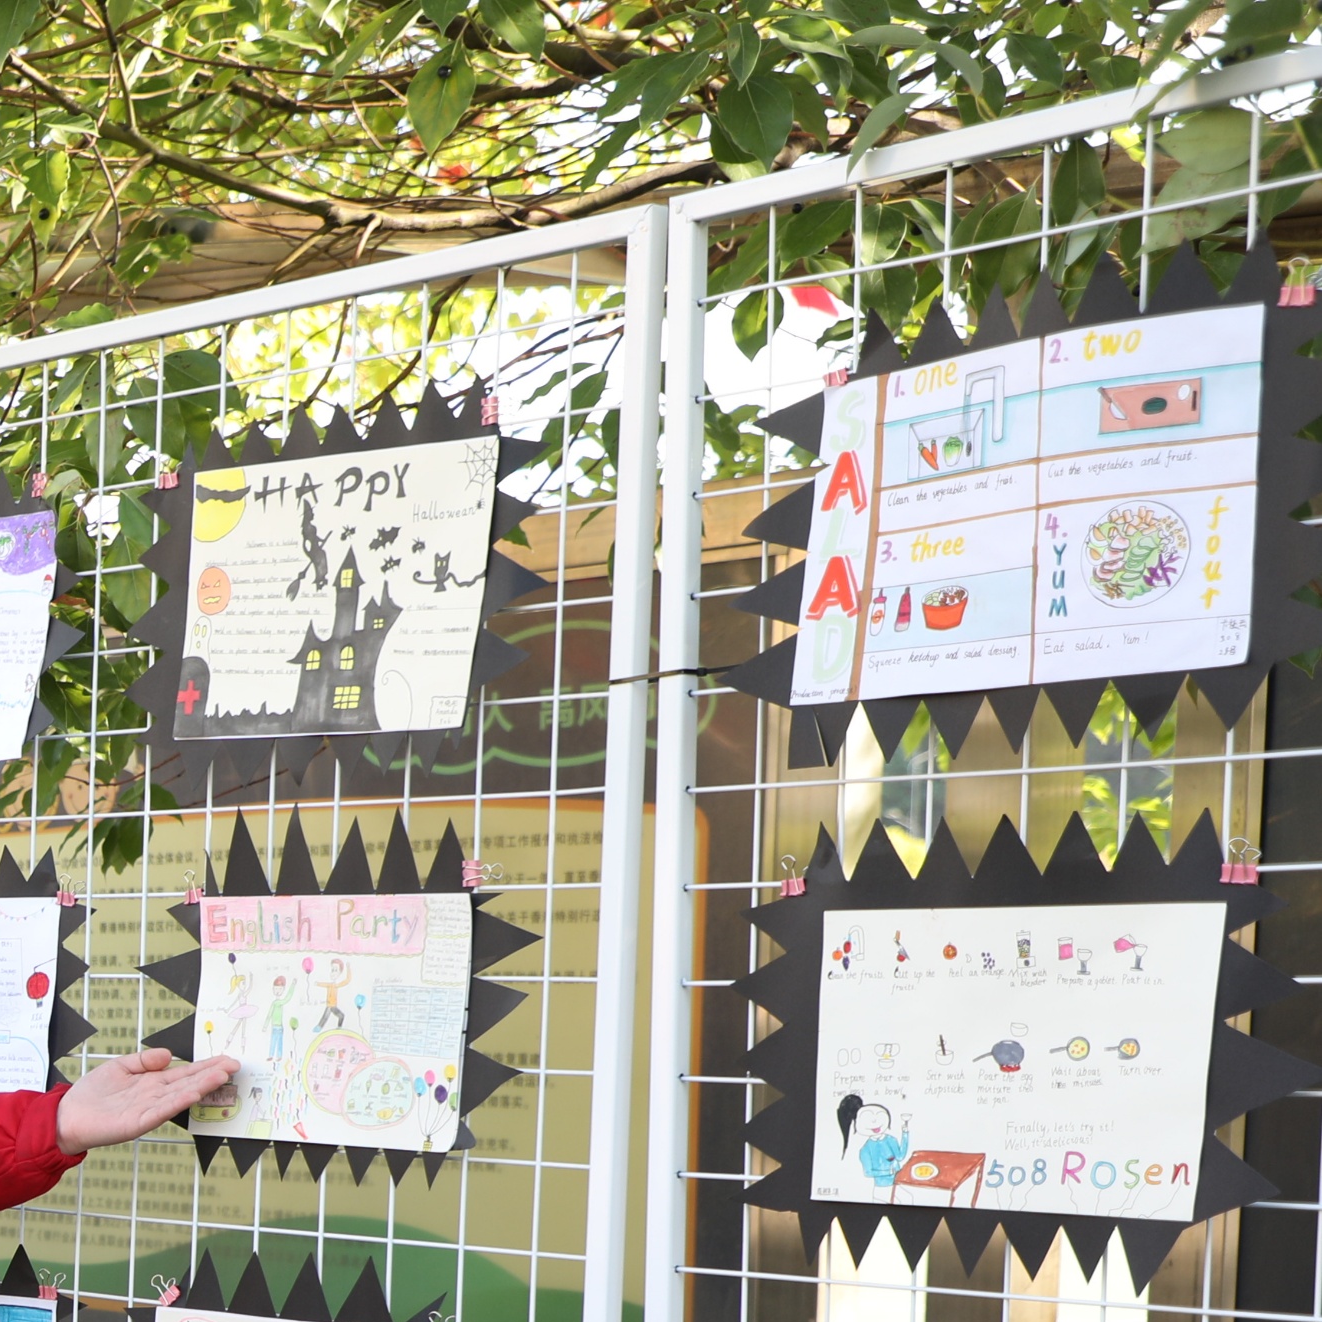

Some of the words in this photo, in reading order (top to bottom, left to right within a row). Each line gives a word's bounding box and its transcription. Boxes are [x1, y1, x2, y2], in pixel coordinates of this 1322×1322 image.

[1048, 338, 1069, 363] 2.
[1083, 329, 1142, 360] two
[894, 376, 906, 398] 1.
[914, 362, 958, 395] one
[1048, 463, 1064, 478] Cut
[1069, 462, 1081, 475] the
[1088, 454, 1133, 476] vegetables
[1141, 452, 1161, 467] and
[1166, 449, 1198, 468] fruit.
[254, 462, 410, 513] HAPPY
[888, 491, 909, 507] Clean
[916, 488, 928, 501] the
[933, 482, 967, 502] vegetables
[974, 476, 989, 490] and
[805, 390, 866, 684] SALAD
[1044, 513, 1068, 539] 4.
[880, 540, 897, 563] 3.
[910, 533, 966, 563] three
[1044, 639, 1065, 655] Eat
[868, 655, 902, 673] Squeeze
[908, 650, 940, 668] ketchup
[945, 649, 958, 660] and
[964, 648, 982, 660] salad
[336, 899, 418, 946] Party
[914, 970, 923, 984] up
[926, 968, 935, 978] the
[949, 967, 964, 978] Peel
[1008, 969, 1029, 979] Mix
[1032, 968, 1047, 978] with
[947, 1070, 965, 1080] with
[1021, 1074, 1034, 1086] egg
[1076, 1066, 1101, 1077] about
[1119, 1065, 1142, 1077] Turn
[1006, 1120, 1050, 1138] Finally,
[1054, 1121, 1075, 1134] let's
[1080, 1123, 1095, 1136] try
[1005, 1138, 1029, 1151] Well,
[985, 1158, 1047, 1188] 508
